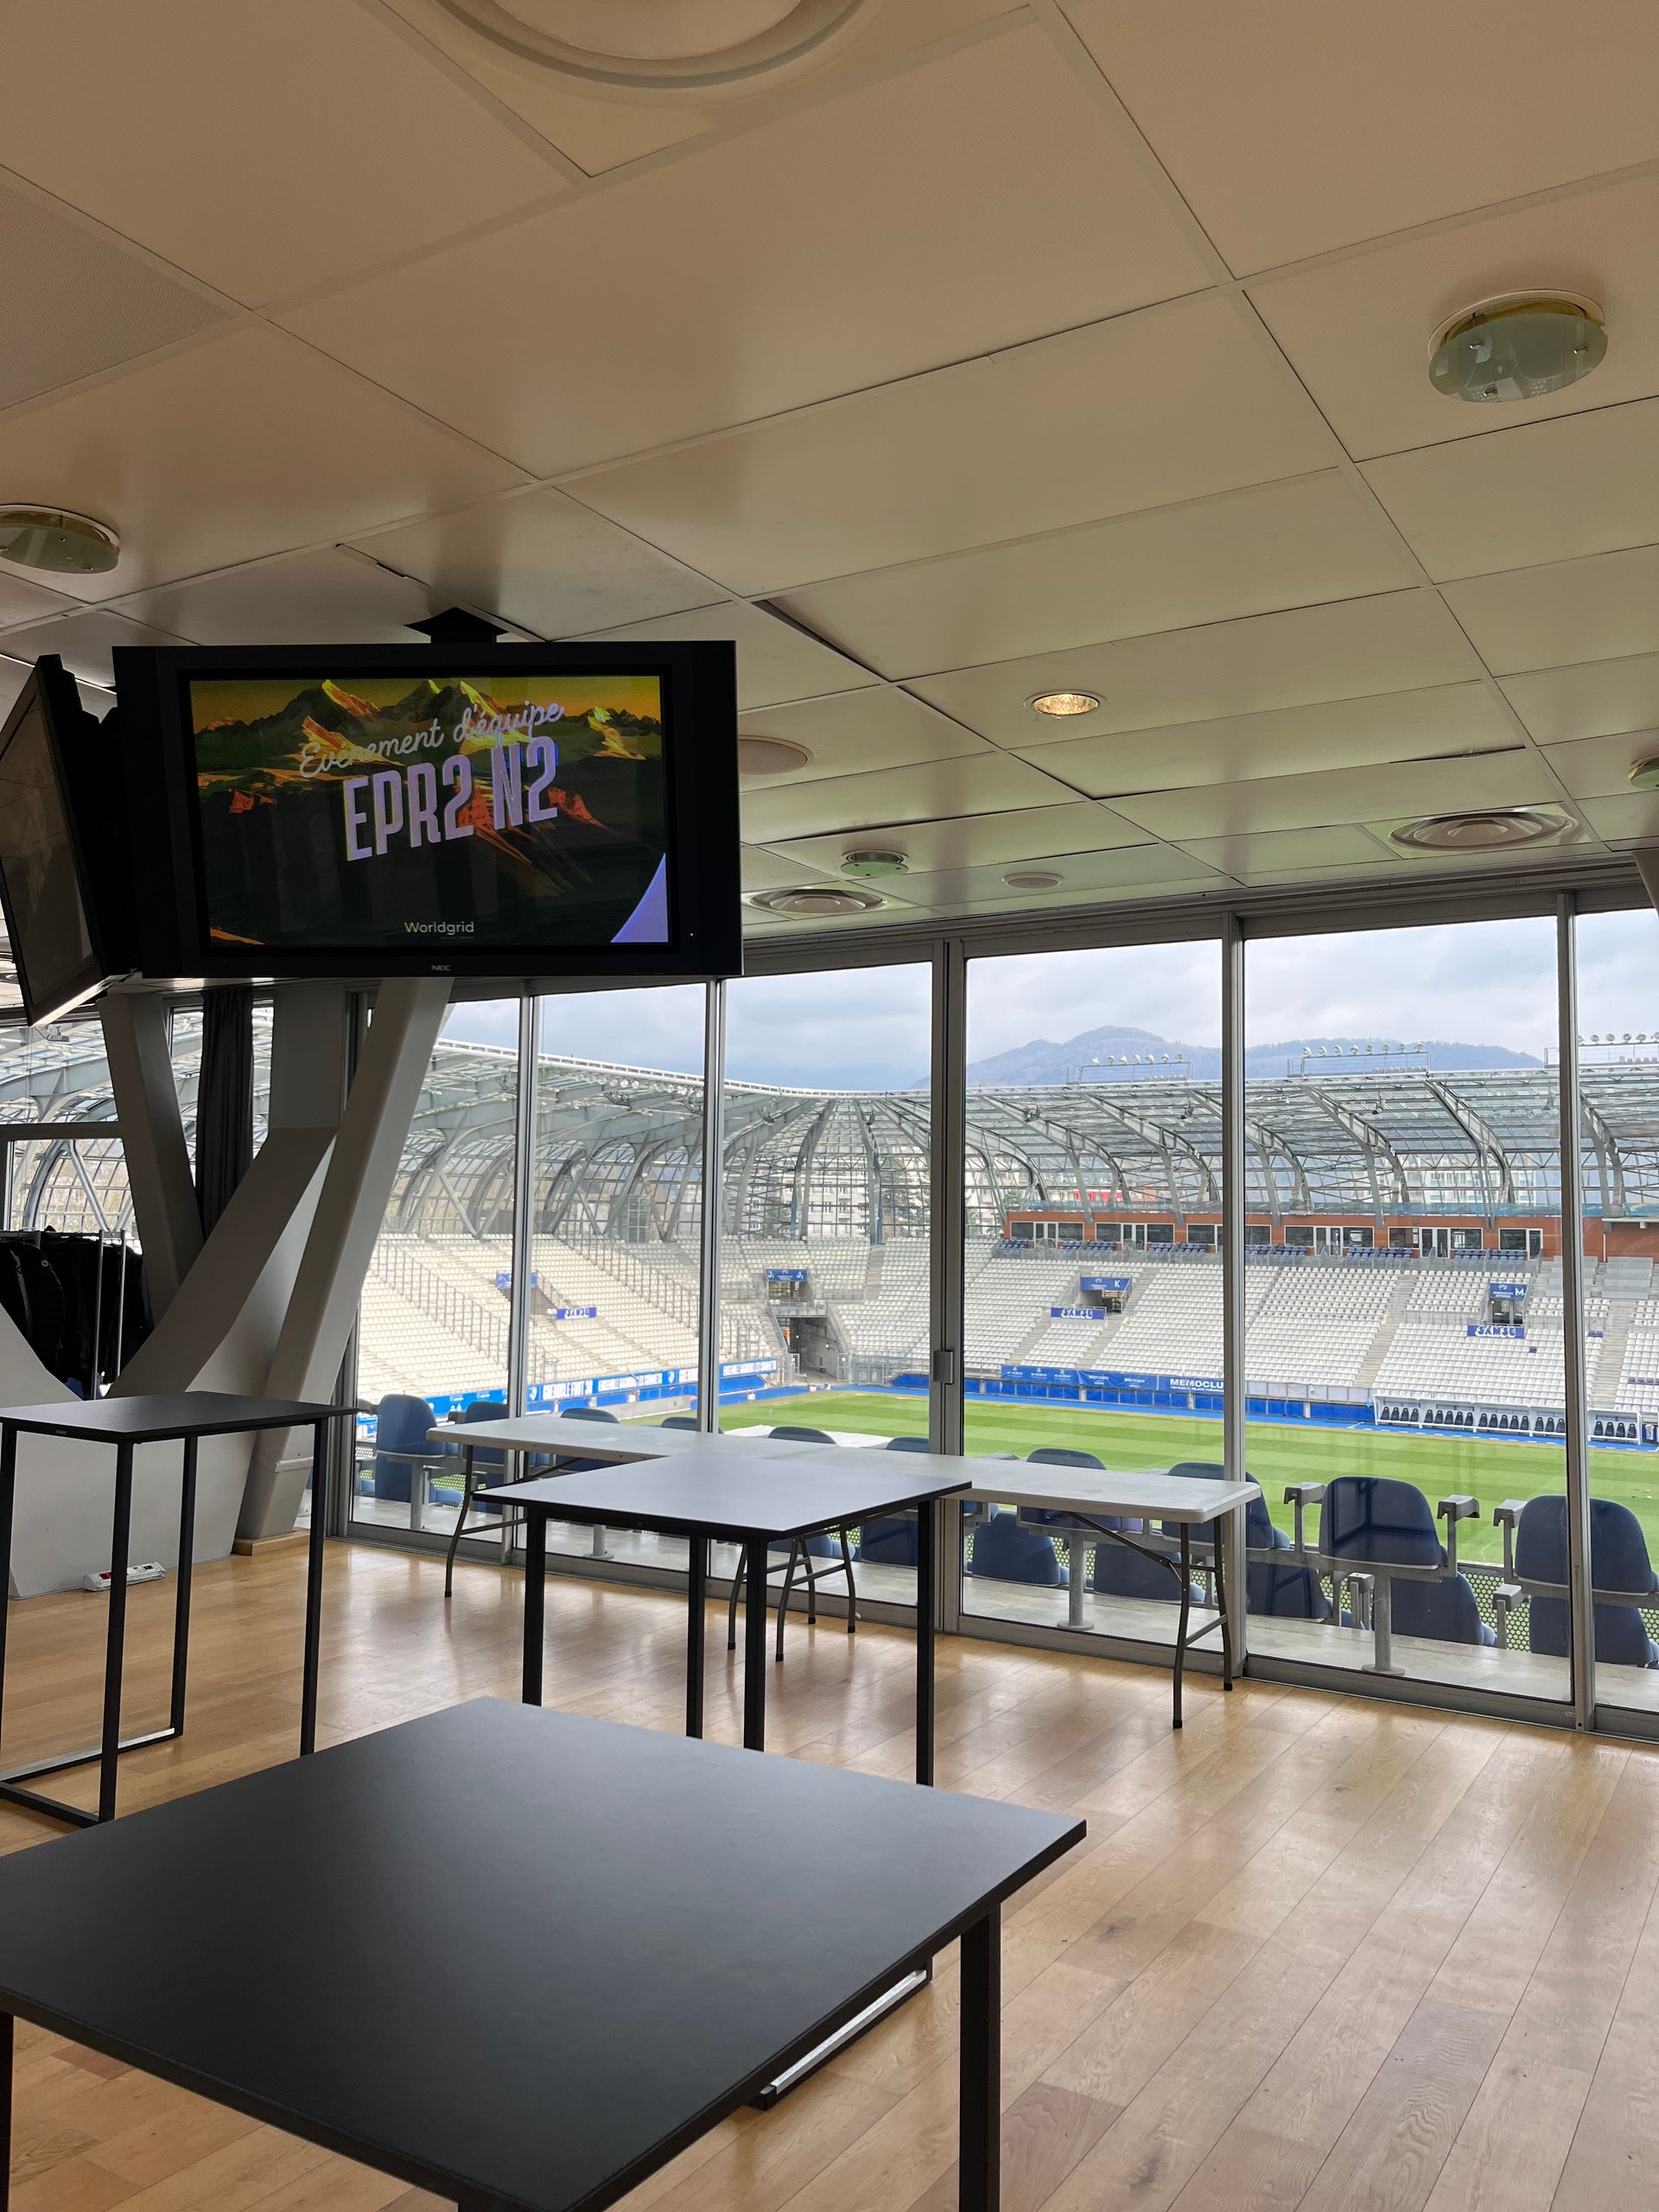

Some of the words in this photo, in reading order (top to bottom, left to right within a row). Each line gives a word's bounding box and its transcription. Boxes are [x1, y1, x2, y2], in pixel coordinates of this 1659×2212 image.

[343, 754, 474, 861] EPR2
[491, 736, 559, 830] N2
[404, 921, 474, 935] Worldgrid
[1061, 1308, 1093, 1319] SAMSE
[1475, 1325, 1516, 1338] SAMSE
